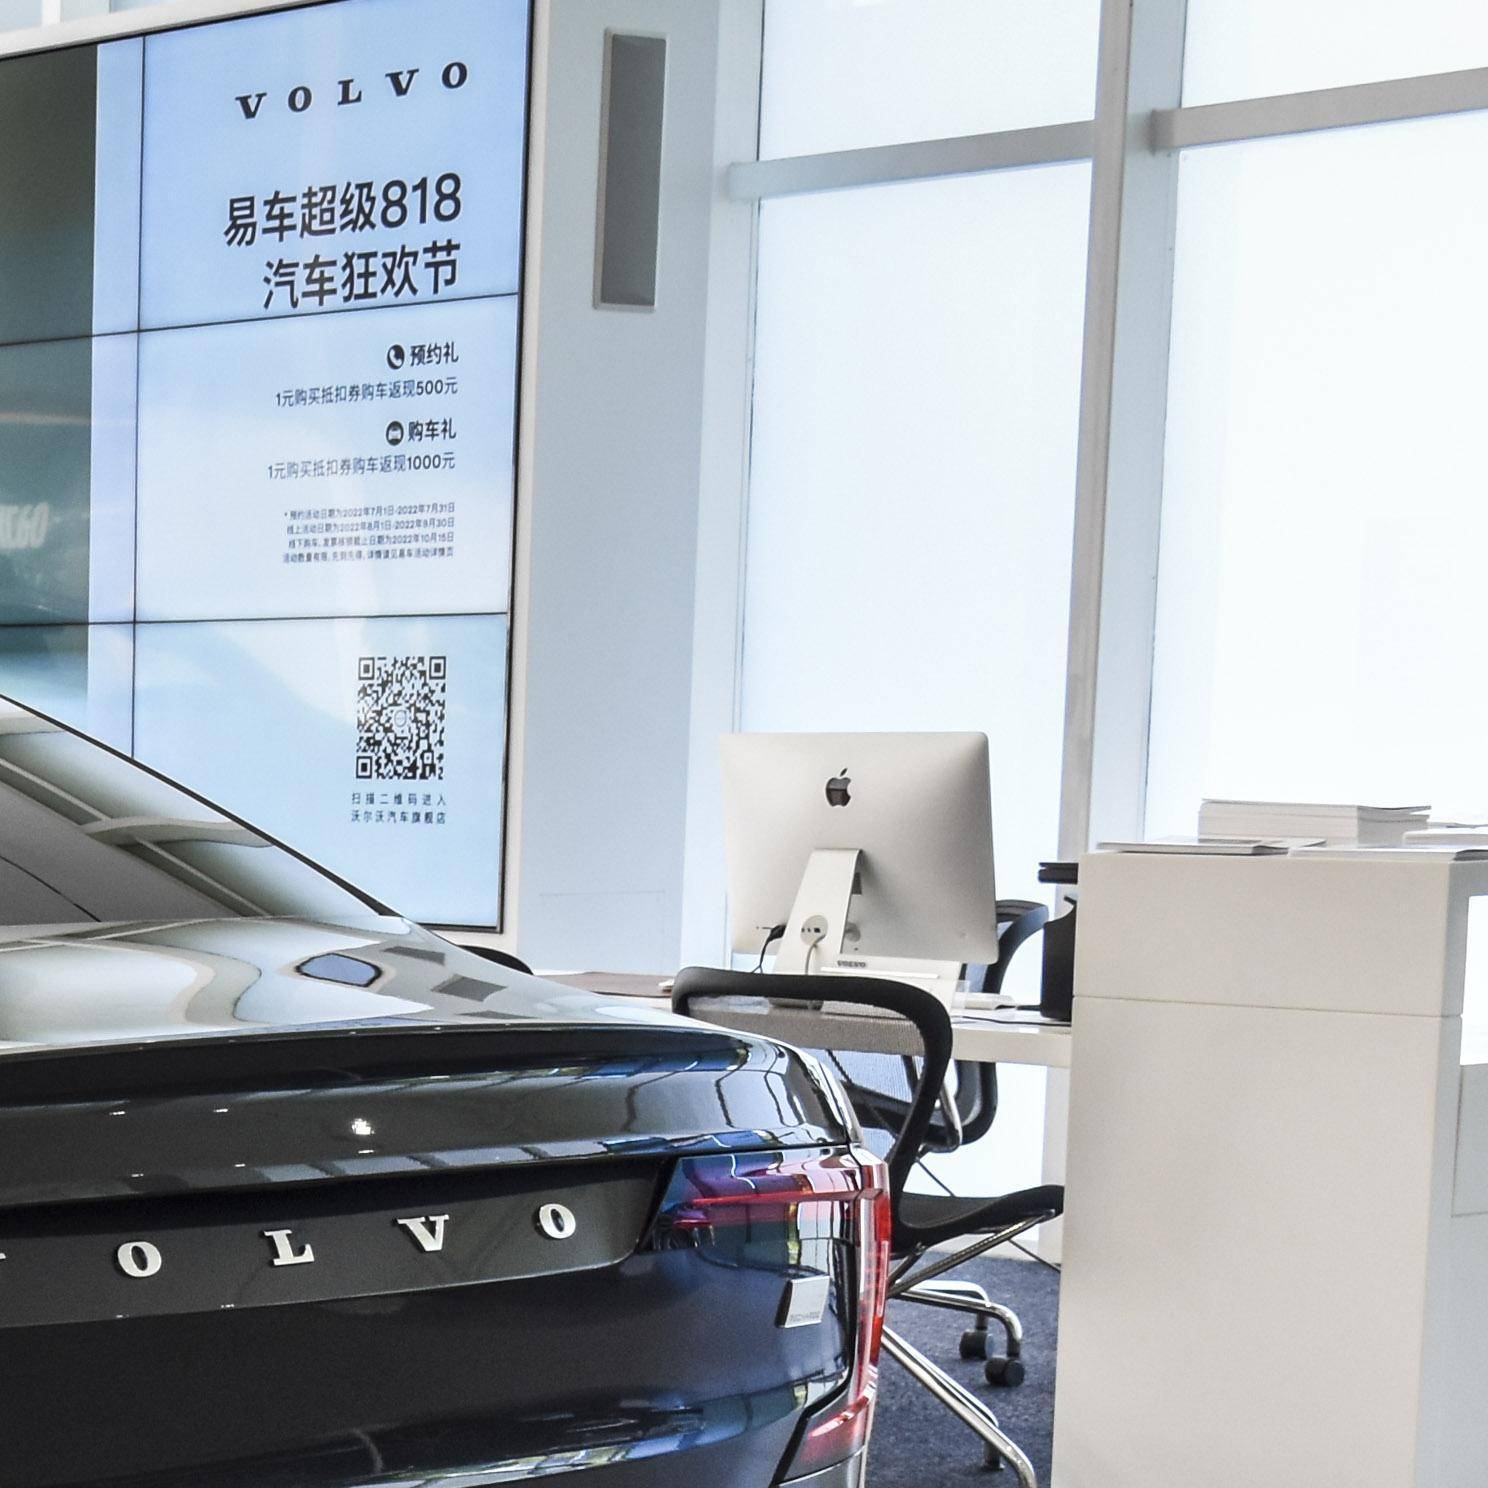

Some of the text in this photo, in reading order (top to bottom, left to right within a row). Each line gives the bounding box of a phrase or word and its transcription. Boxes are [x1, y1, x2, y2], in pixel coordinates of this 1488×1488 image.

[235, 61, 468, 119] VOLVO
[224, 172, 462, 247] 易车超级818
[263, 239, 461, 310] 汽车狂欢节
[410, 341, 459, 367] 预约礼
[276, 376, 458, 408] 1元购买抵扣券购车返现500元
[408, 418, 456, 442] 购车礼
[268, 452, 456, 480] 1元购买抵扣券购车返现1000元
[351, 792, 446, 805] 扫描二维码进入
[351, 810, 446, 824] 沃尔沃汽车旗舰店
